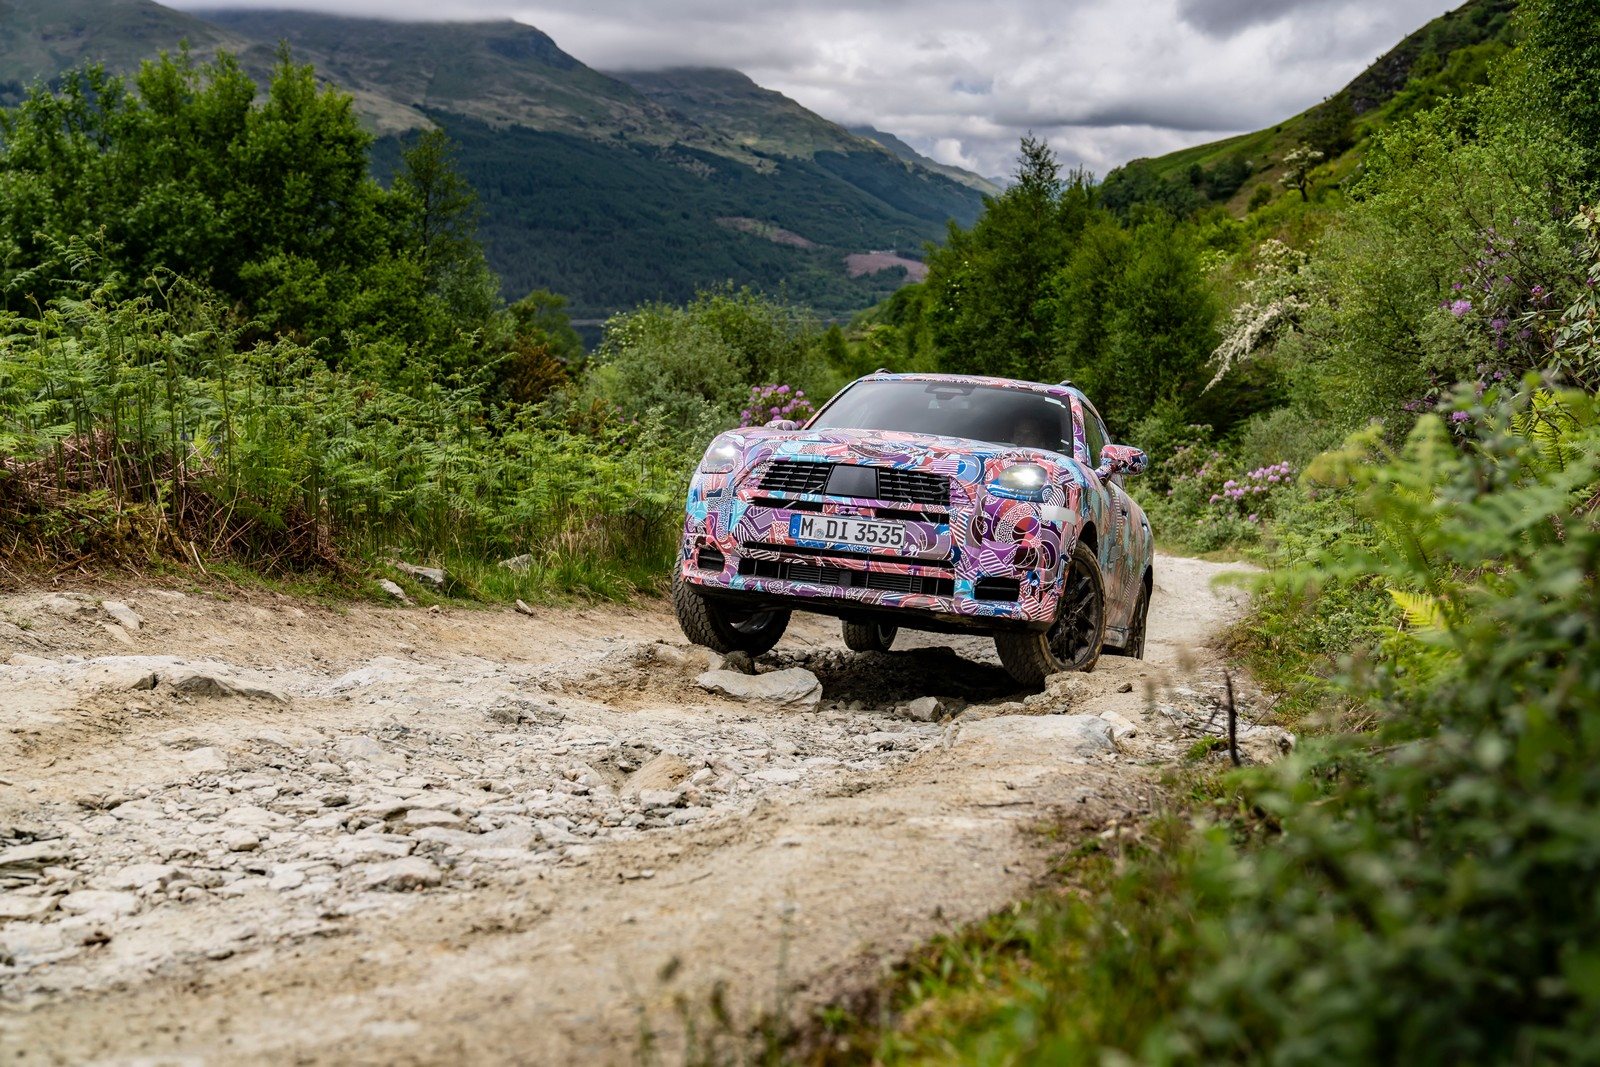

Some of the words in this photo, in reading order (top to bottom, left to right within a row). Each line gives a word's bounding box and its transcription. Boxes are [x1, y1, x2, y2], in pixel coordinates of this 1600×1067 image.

[801, 518, 814, 537] M
[825, 520, 848, 540] DI
[854, 523, 903, 546] 3535
